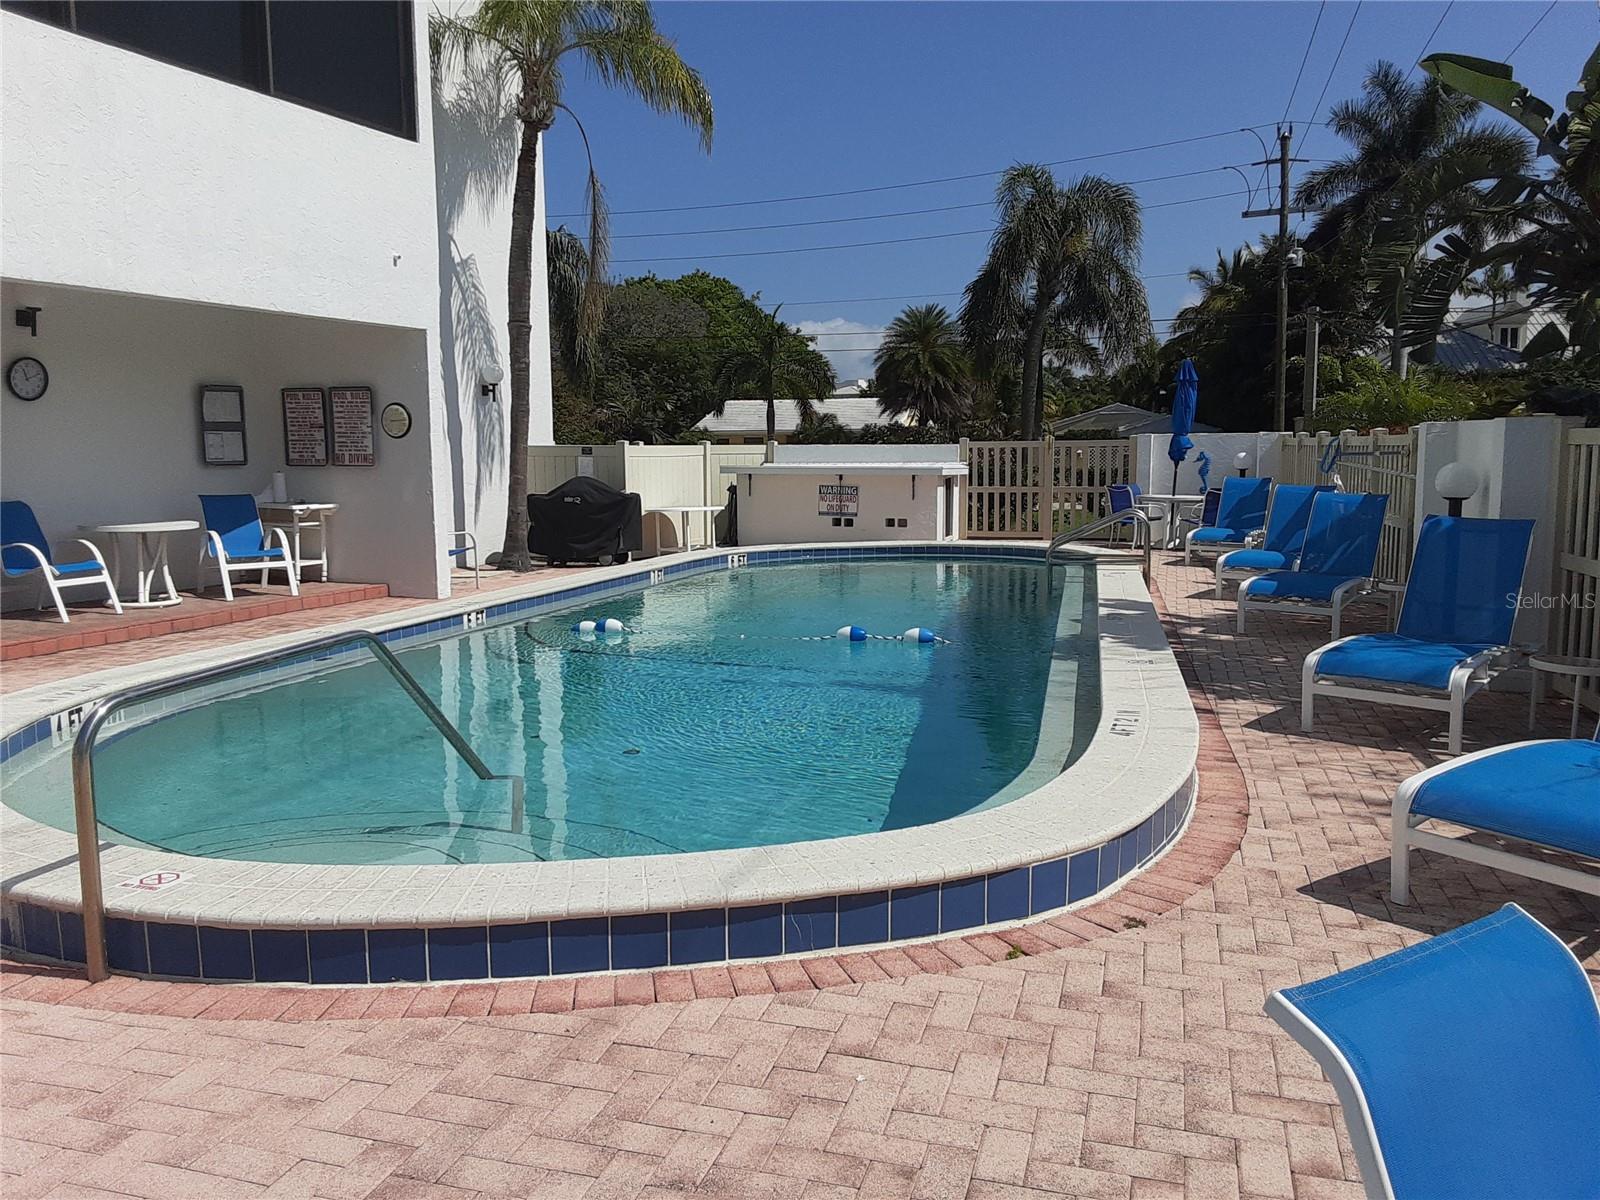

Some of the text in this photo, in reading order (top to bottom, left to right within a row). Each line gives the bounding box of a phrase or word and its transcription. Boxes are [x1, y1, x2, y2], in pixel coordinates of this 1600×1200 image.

[333, 391, 369, 400] POOL RULES
[336, 453, 374, 464] NO DIVING
[820, 486, 857, 495] WARNING
[820, 494, 857, 503] NO LIFEGUARD
[68, 706, 83, 728] FT
